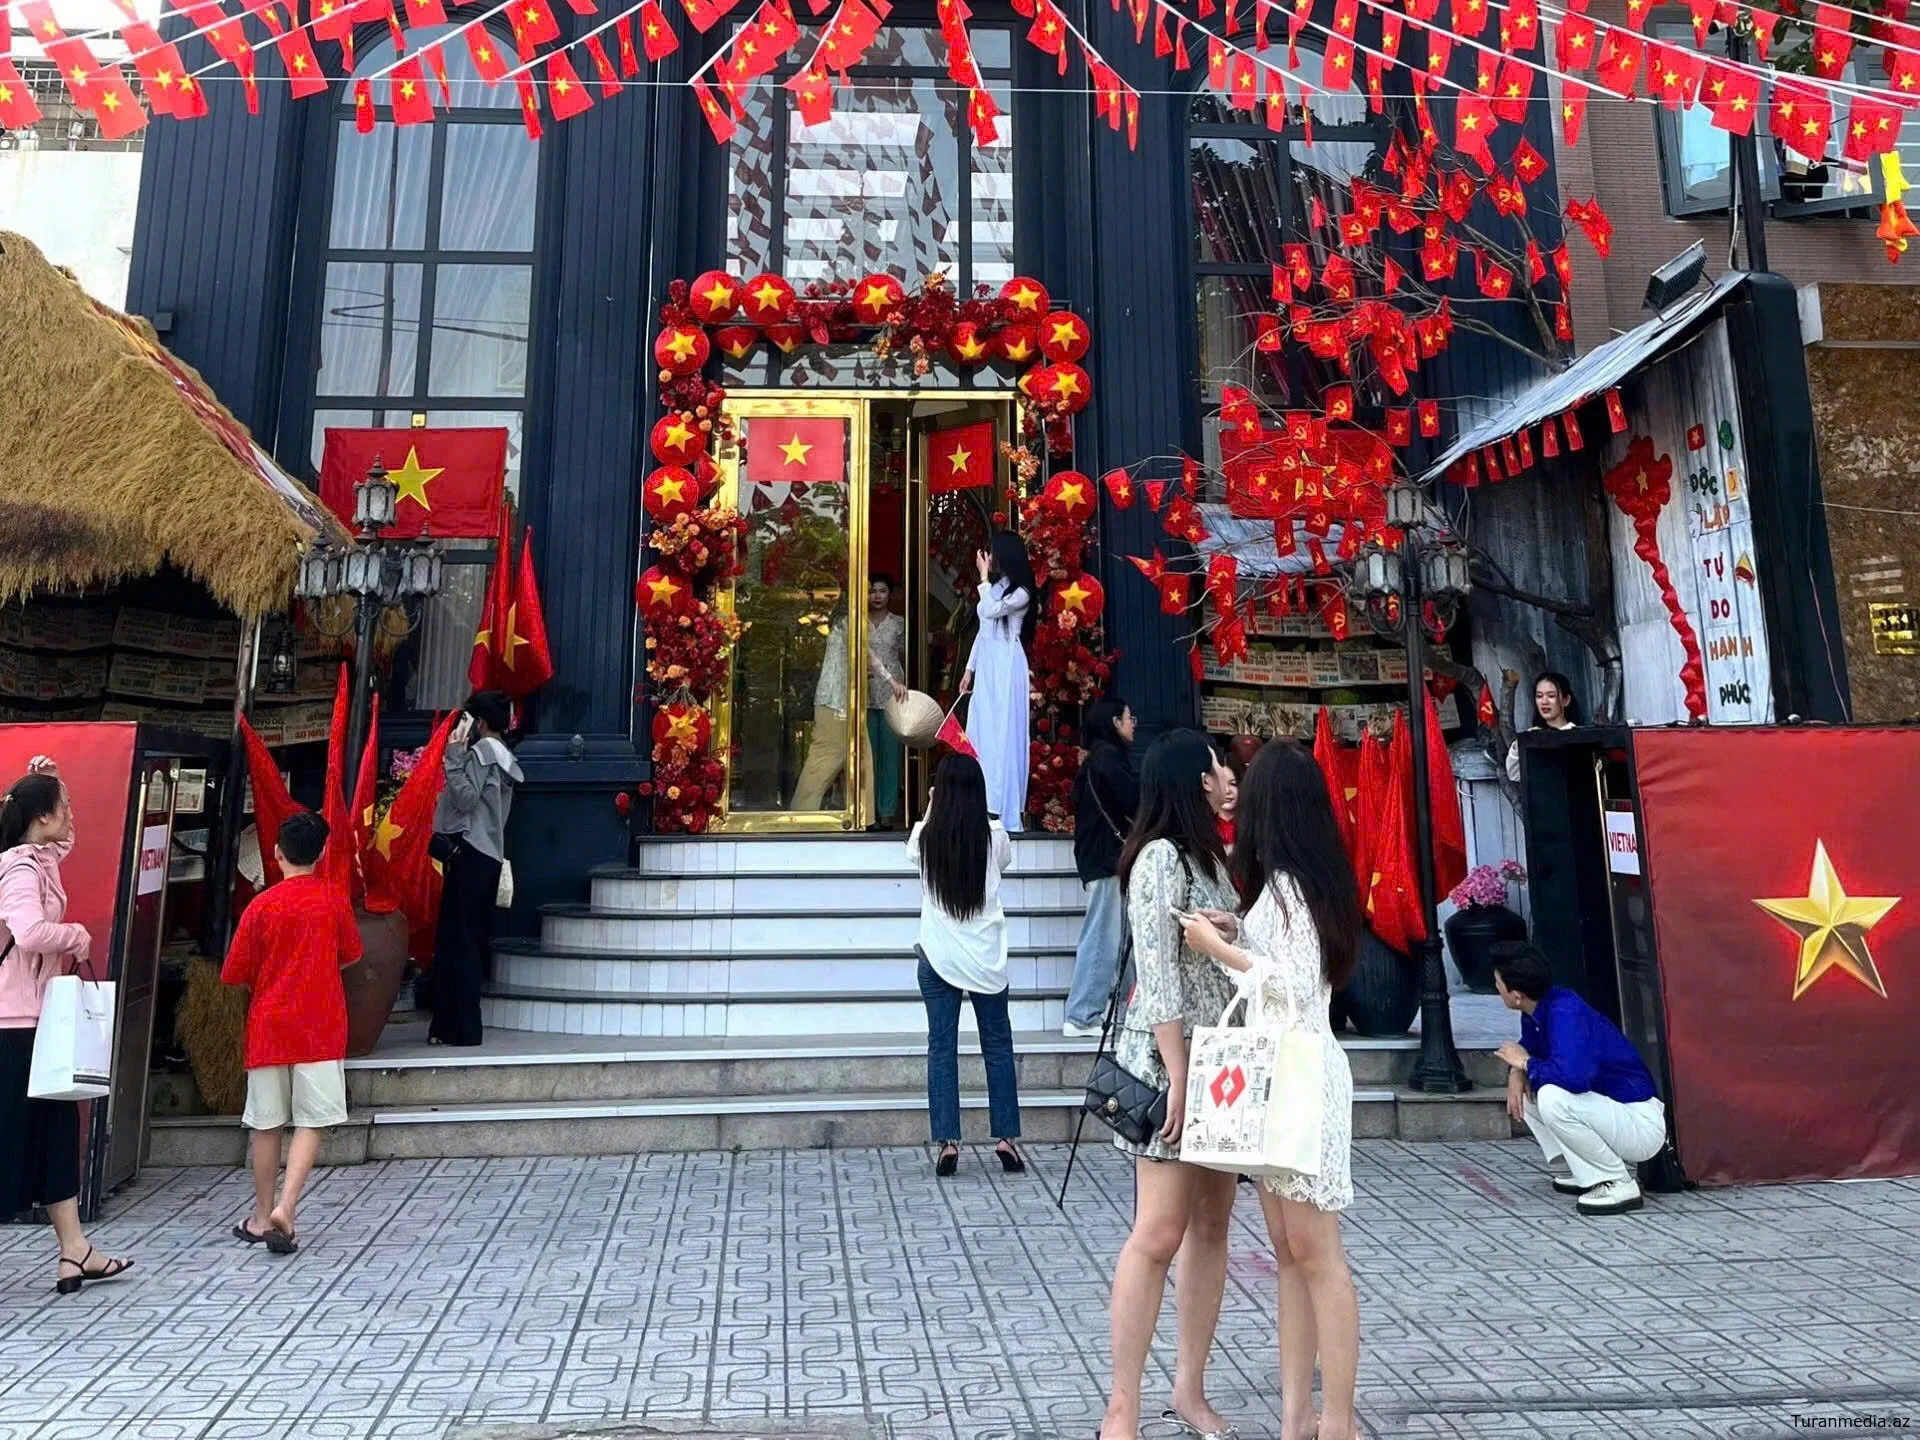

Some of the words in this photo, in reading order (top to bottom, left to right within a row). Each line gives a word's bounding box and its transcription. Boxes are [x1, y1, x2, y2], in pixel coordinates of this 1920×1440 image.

[1703, 551, 1724, 582] TỰ
[1711, 598, 1730, 619] DO
[1719, 678, 1752, 707] PHÚC
[1608, 831, 1639, 854] VIETNA
